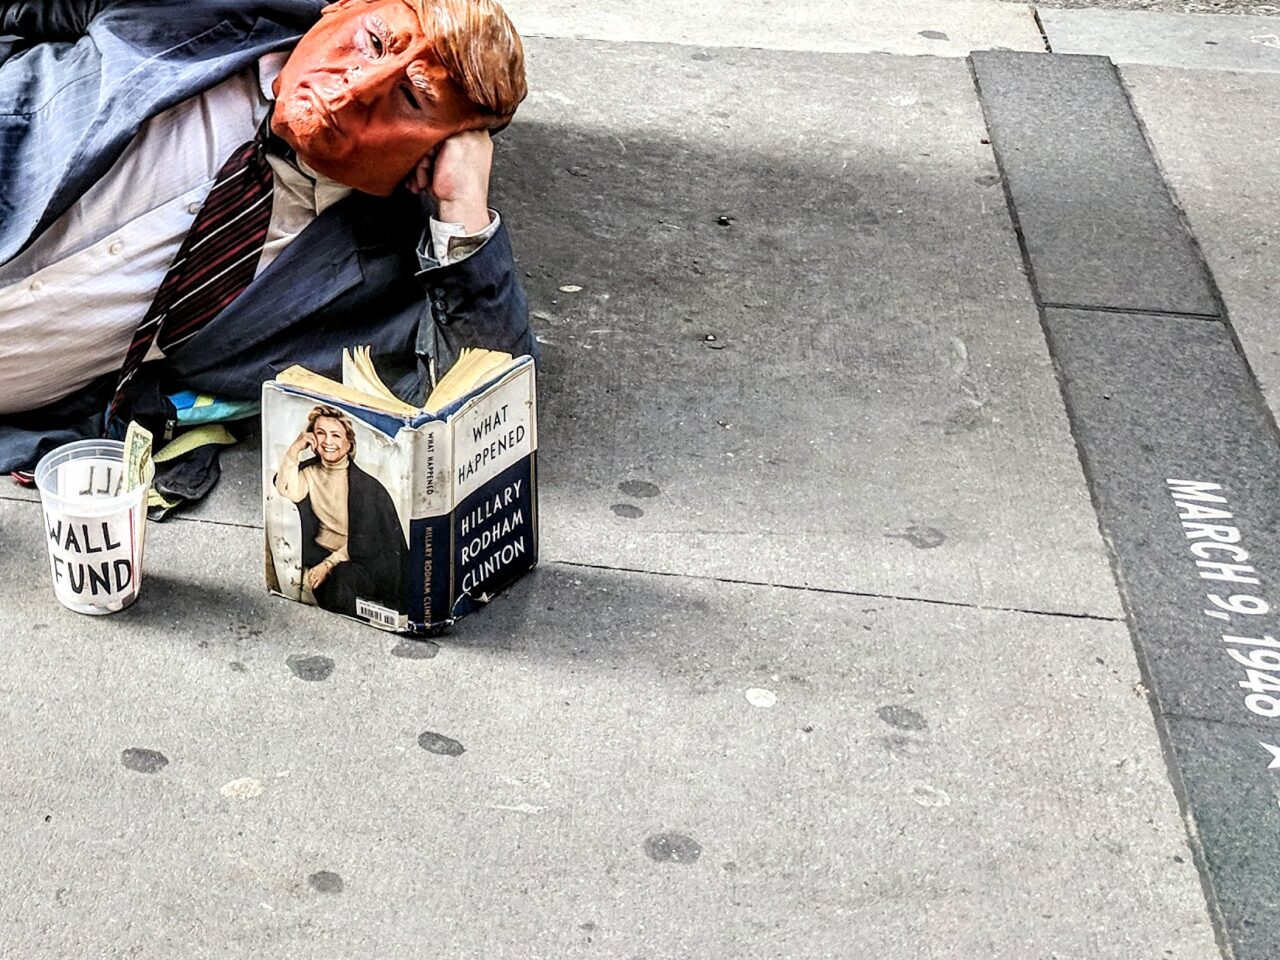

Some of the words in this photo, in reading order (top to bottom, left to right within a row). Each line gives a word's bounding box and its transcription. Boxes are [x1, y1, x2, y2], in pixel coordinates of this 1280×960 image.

[427, 431, 435, 453] WHAT
[472, 404, 510, 443] WHAT
[426, 456, 434, 495] HAPPENED
[458, 424, 525, 485] HAPPENED
[461, 479, 523, 537] HILLARY
[46, 511, 121, 554] WALL
[461, 508, 524, 566] RODHAM
[1166, 478, 1261, 585] MARCH
[53, 555, 132, 596] FUND
[462, 536, 526, 593] CLINTON
[1204, 593, 1270, 621] 9,
